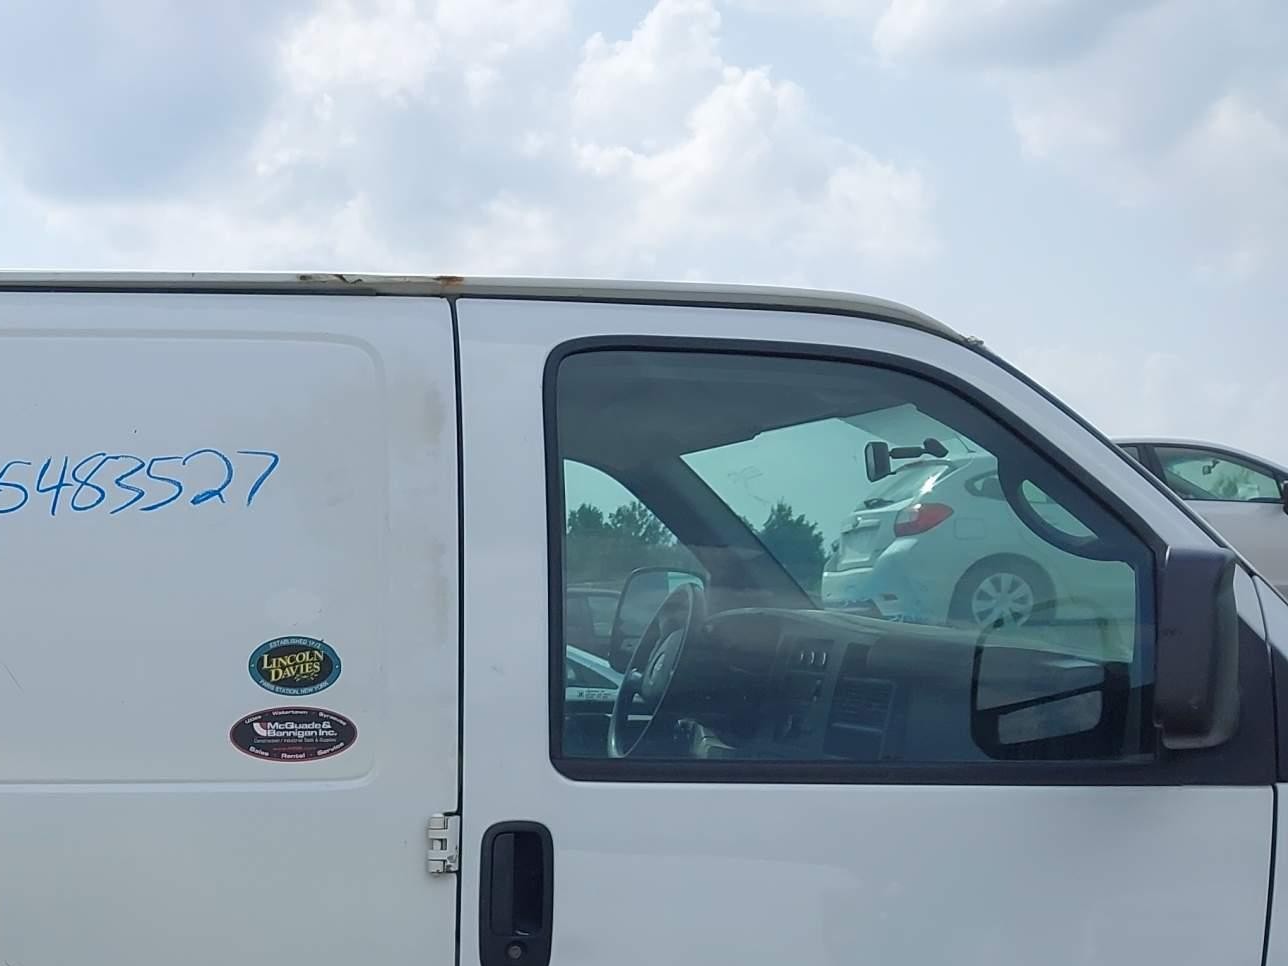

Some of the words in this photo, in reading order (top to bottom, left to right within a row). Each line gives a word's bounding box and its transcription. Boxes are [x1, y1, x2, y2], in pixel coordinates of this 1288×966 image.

[262, 650, 324, 669] LINCOLN
[270, 661, 321, 682] DAVIES
[322, 721, 332, 729] &
[318, 728, 338, 737] Inc.
